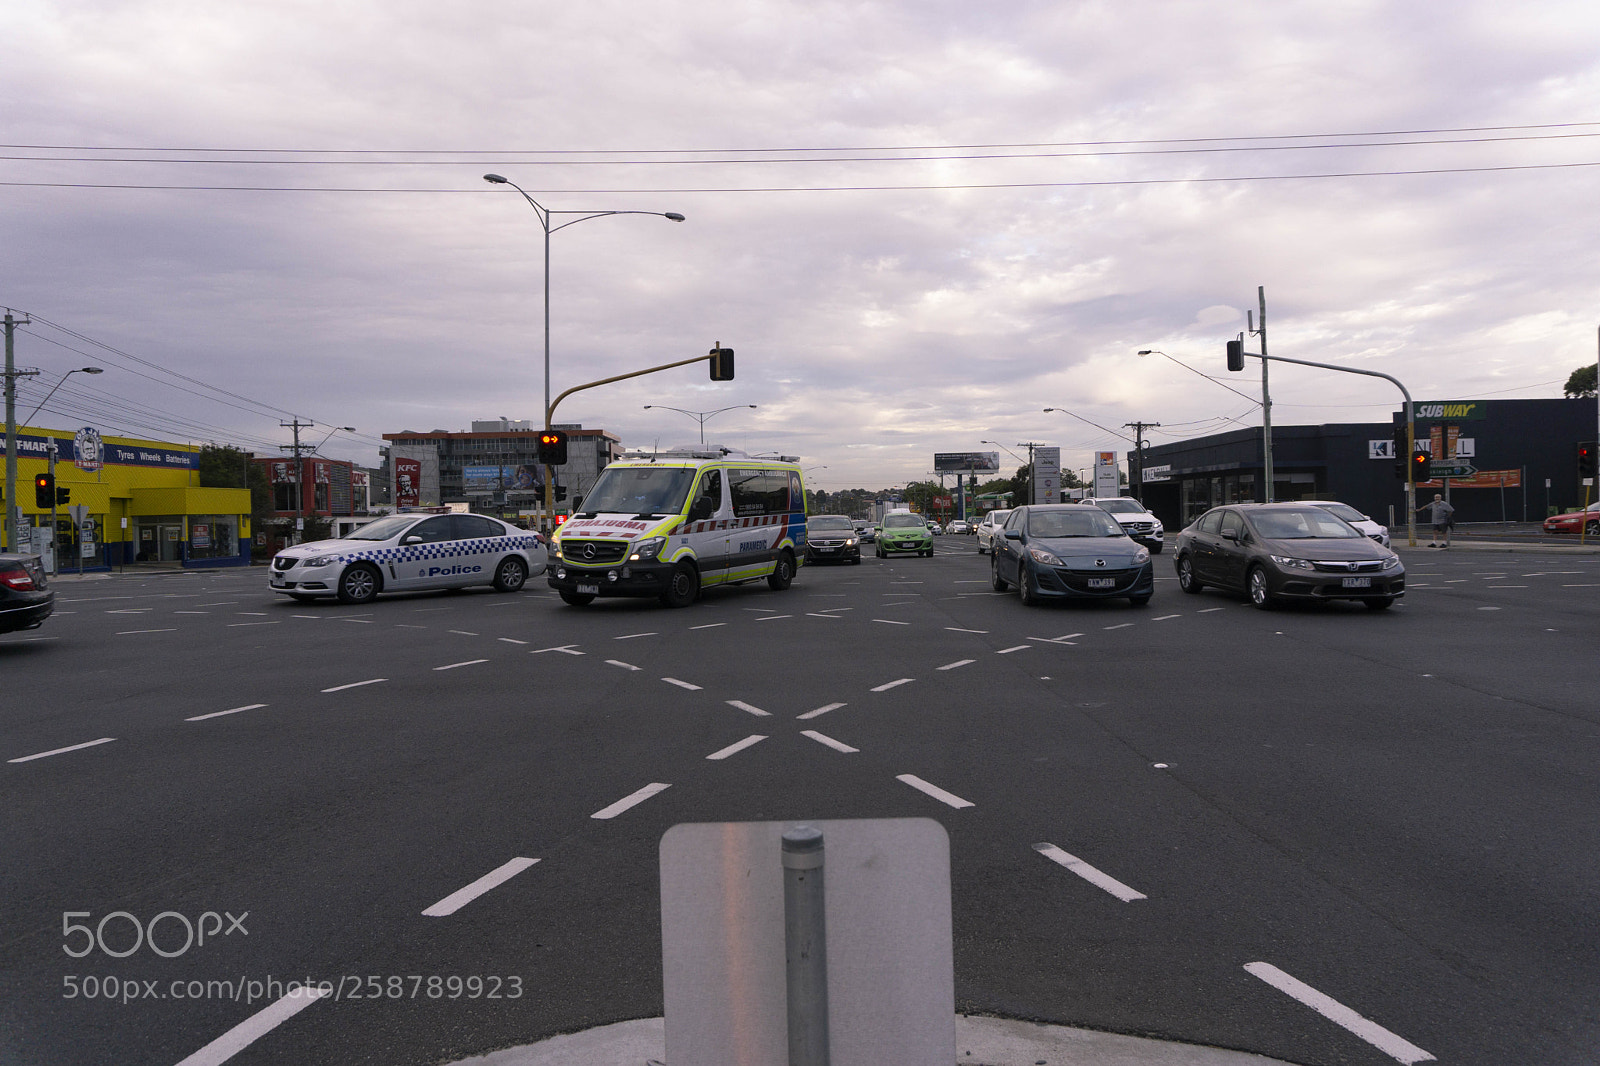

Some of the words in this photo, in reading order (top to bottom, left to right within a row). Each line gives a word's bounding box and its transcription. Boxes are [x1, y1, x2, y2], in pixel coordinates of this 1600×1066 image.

[1416, 403, 1476, 418] SUBWAY
[117, 449, 135, 461] Tyres
[139, 451, 161, 462] Wheels
[165, 454, 190, 464] Batteries
[398, 464, 417, 472] KFC
[739, 539, 767, 552] PARAMEDIC
[428, 565, 482, 577] Police
